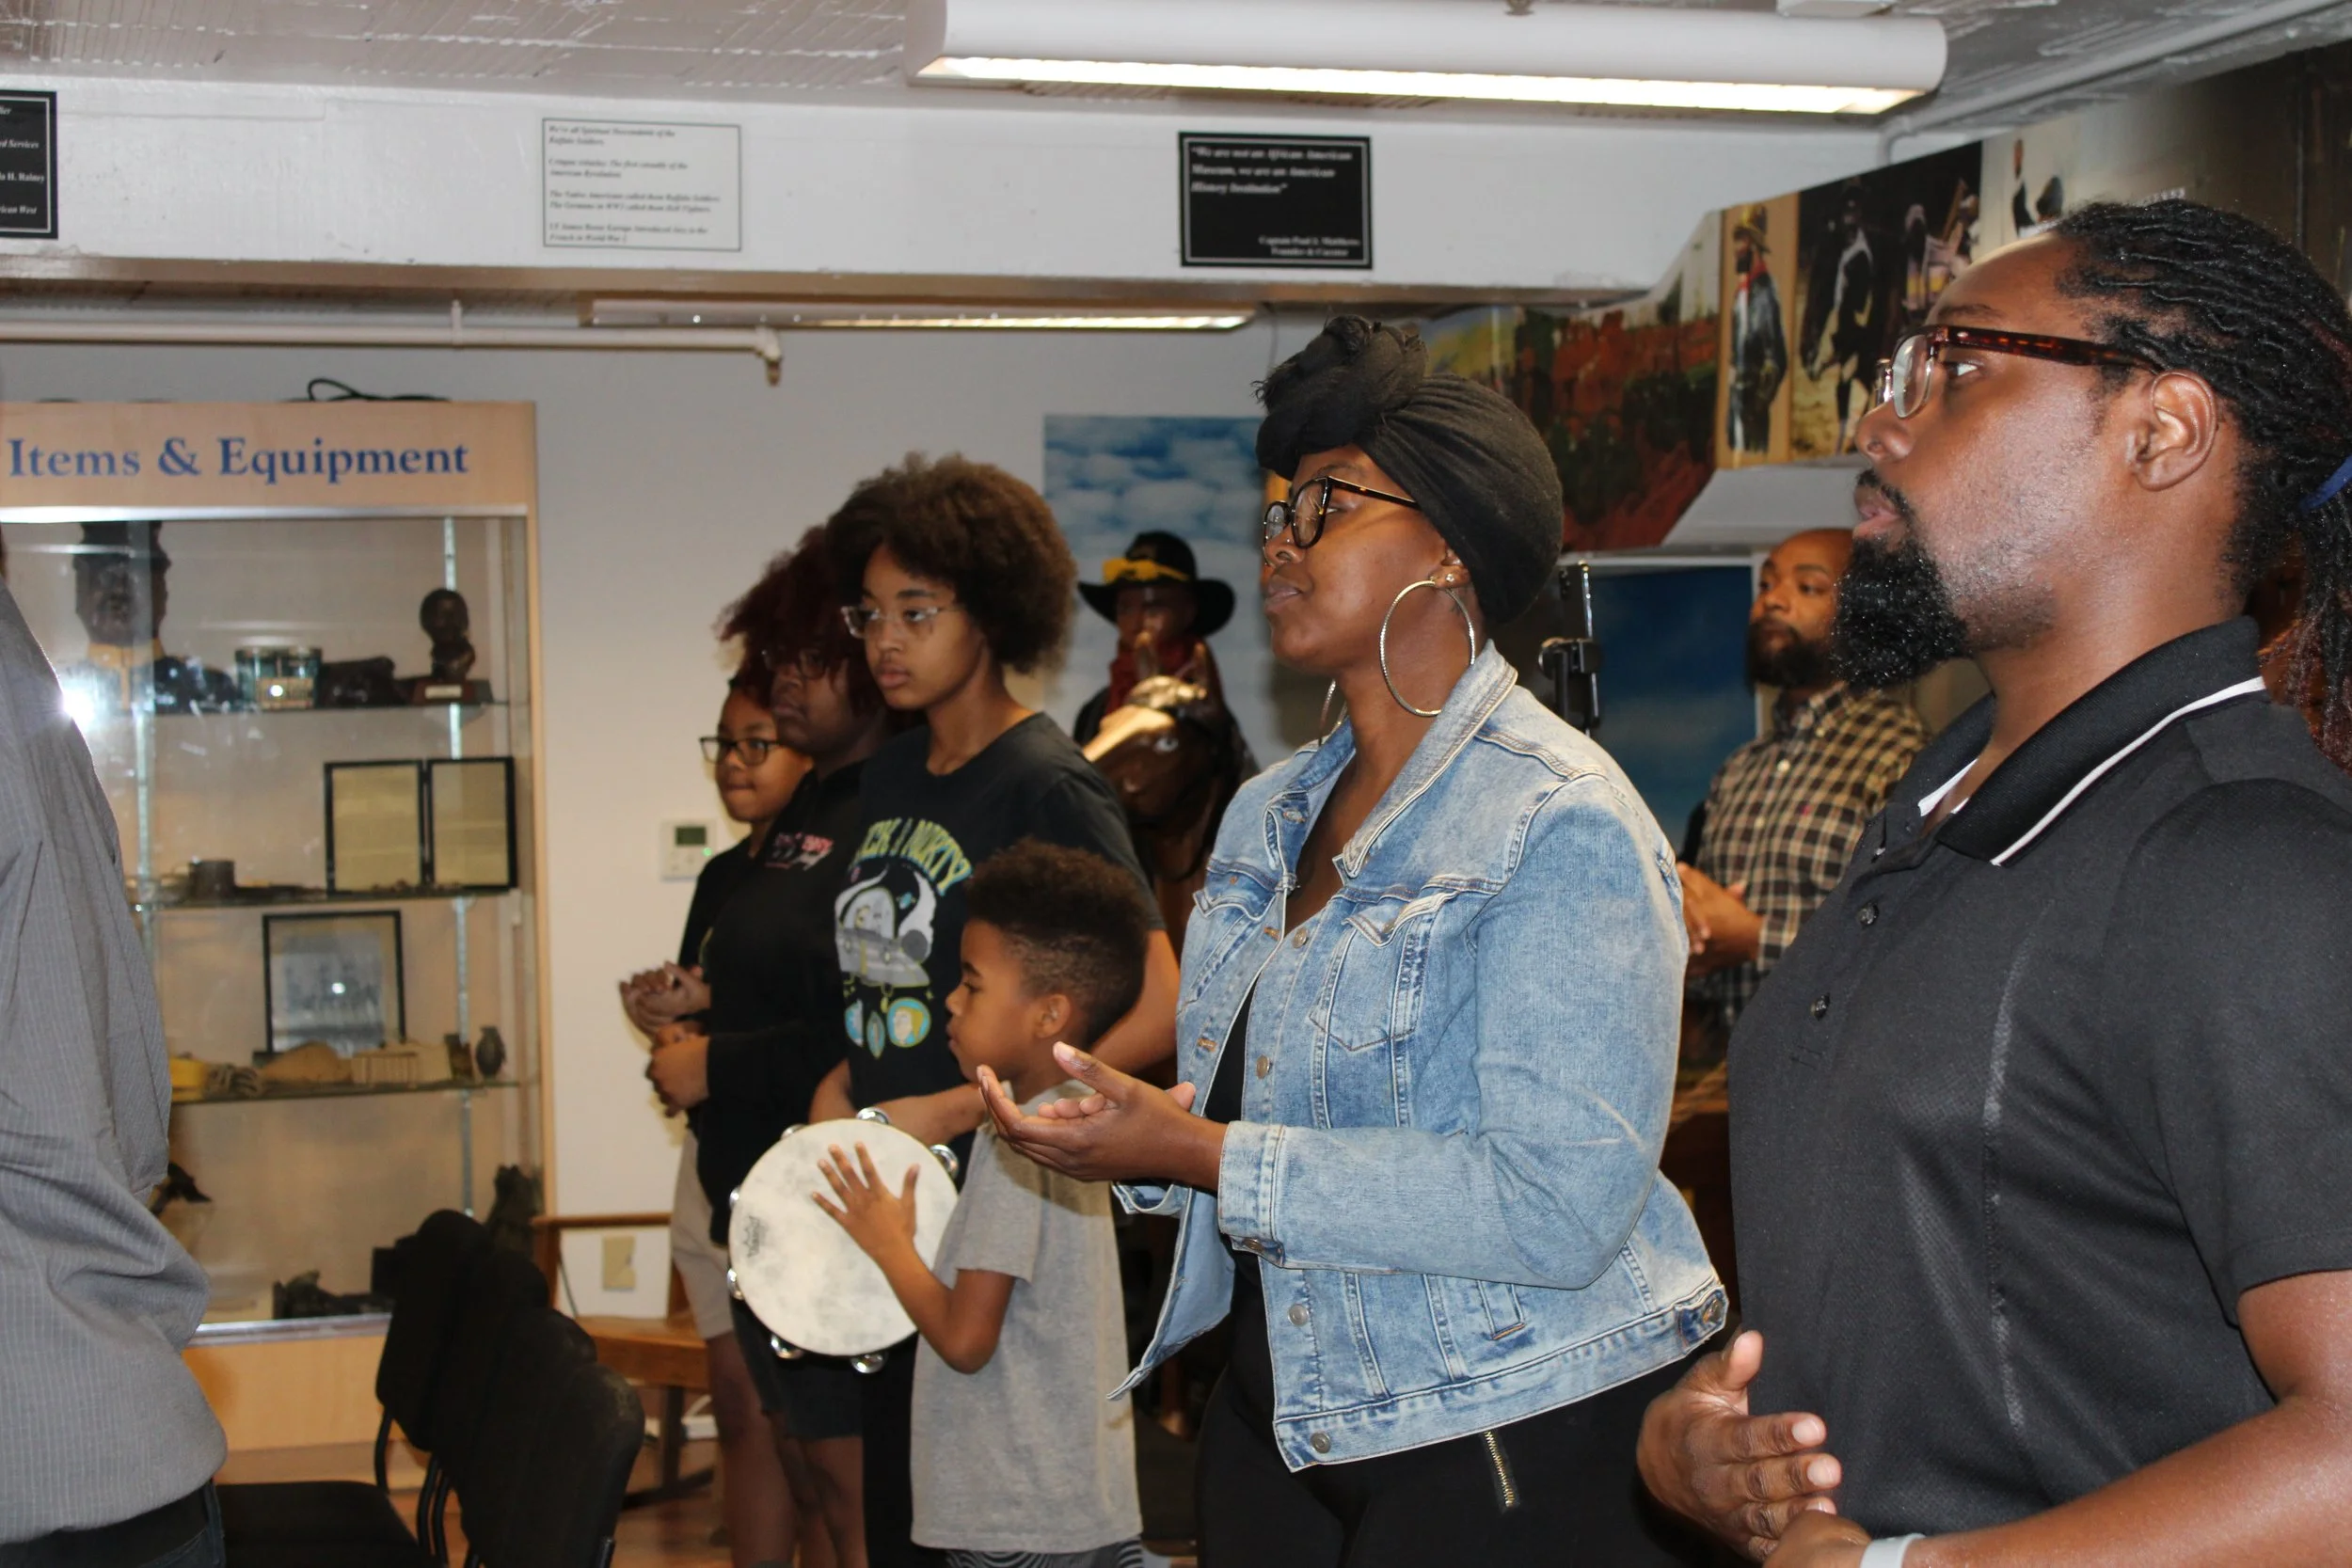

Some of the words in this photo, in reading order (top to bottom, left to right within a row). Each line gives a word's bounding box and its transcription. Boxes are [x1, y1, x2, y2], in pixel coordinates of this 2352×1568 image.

[7, 438, 140, 478] Items
[157, 436, 200, 477] &
[217, 436, 469, 485] Equipment
